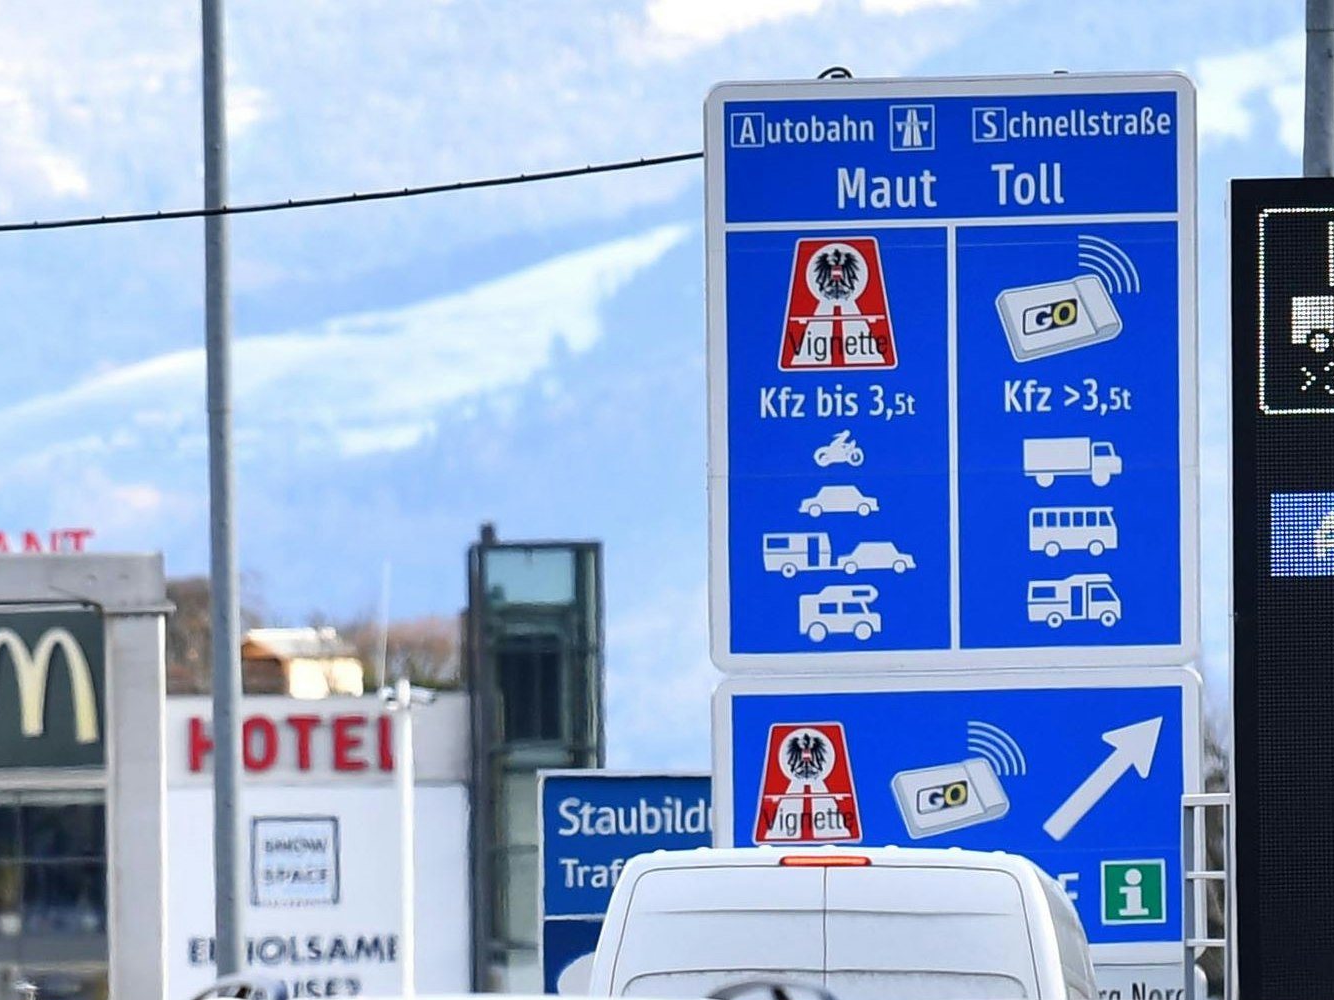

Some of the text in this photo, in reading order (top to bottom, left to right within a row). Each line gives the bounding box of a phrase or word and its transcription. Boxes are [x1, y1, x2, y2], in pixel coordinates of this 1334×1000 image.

[736, 105, 1172, 146] Autobahn Schnellstraße
[836, 162, 1065, 209] Maut Toll
[1032, 299, 1078, 328] GO
[788, 330, 888, 362] Vignette
[759, 383, 916, 421] Kfz bis 3,5t
[1003, 378, 1132, 416] Kfz >3,5t
[762, 780, 969, 837] Vignette GO
